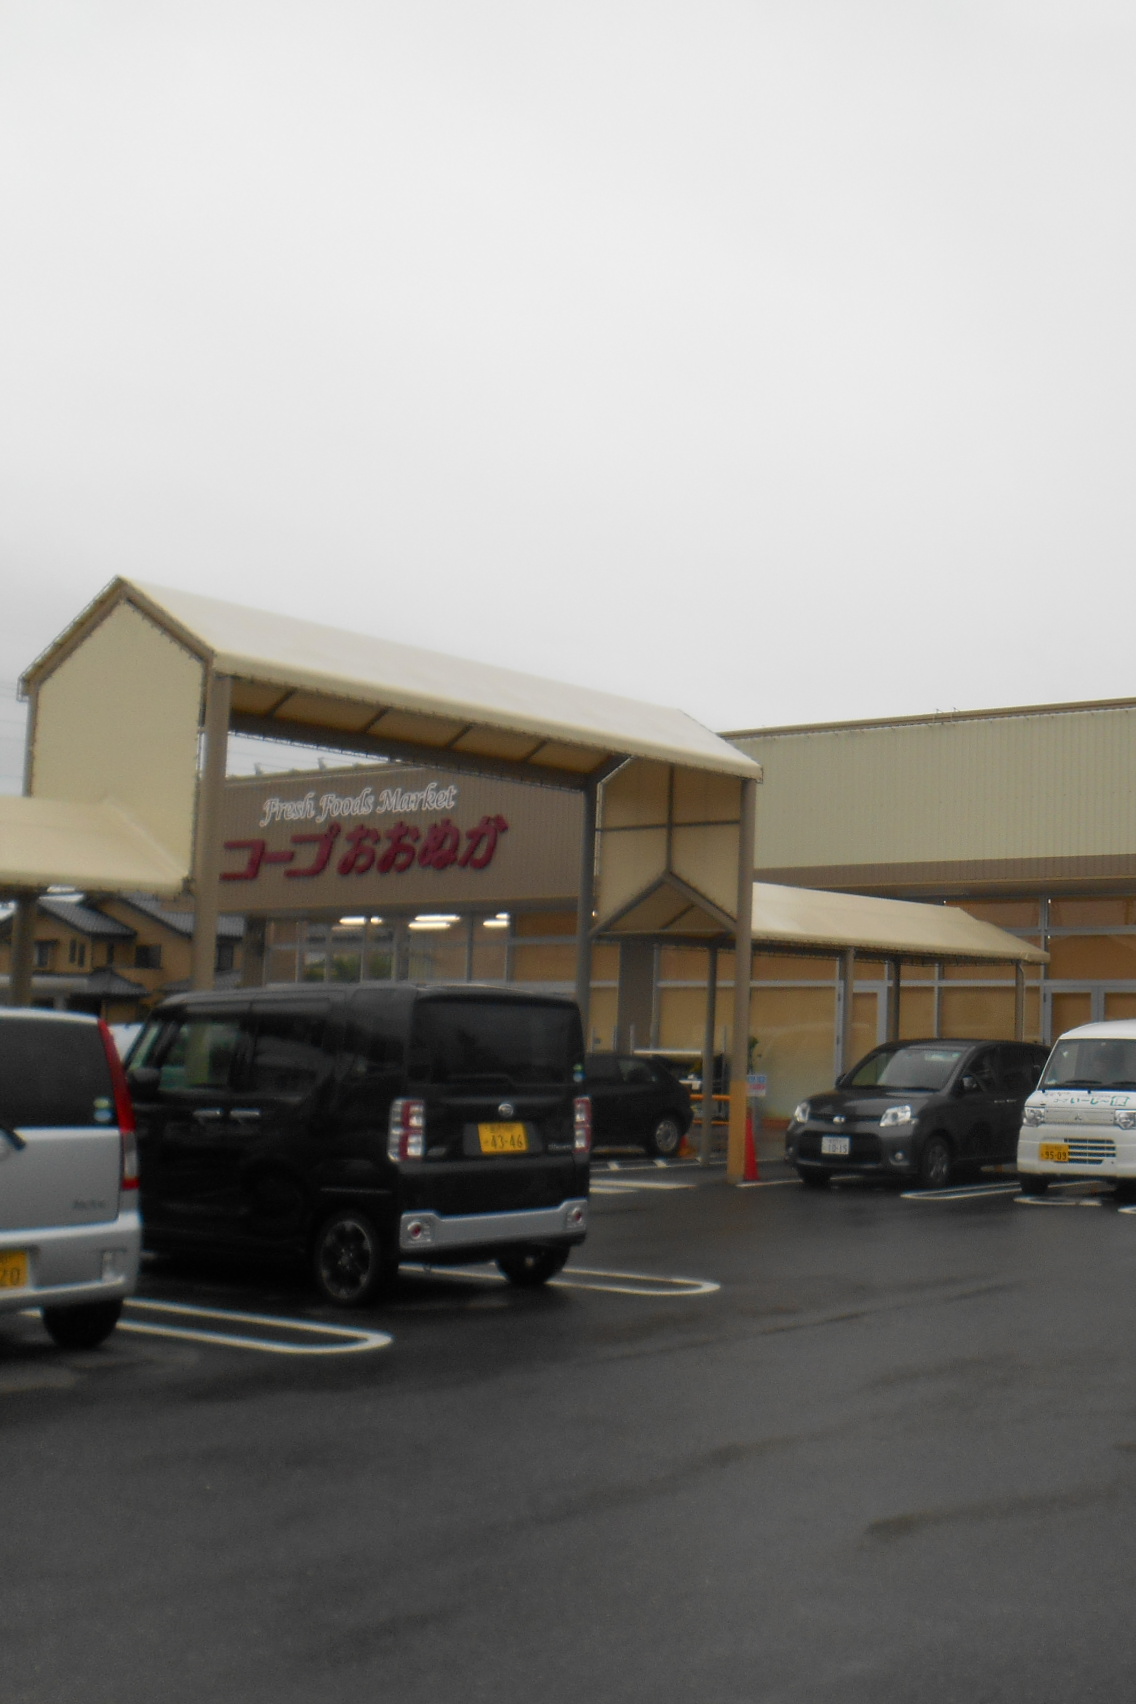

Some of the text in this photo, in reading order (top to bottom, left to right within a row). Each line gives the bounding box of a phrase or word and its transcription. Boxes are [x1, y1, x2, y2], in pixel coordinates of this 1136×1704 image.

[259, 782, 459, 827] Fresh Foods Market
[218, 813, 510, 882] コープおおぬか
